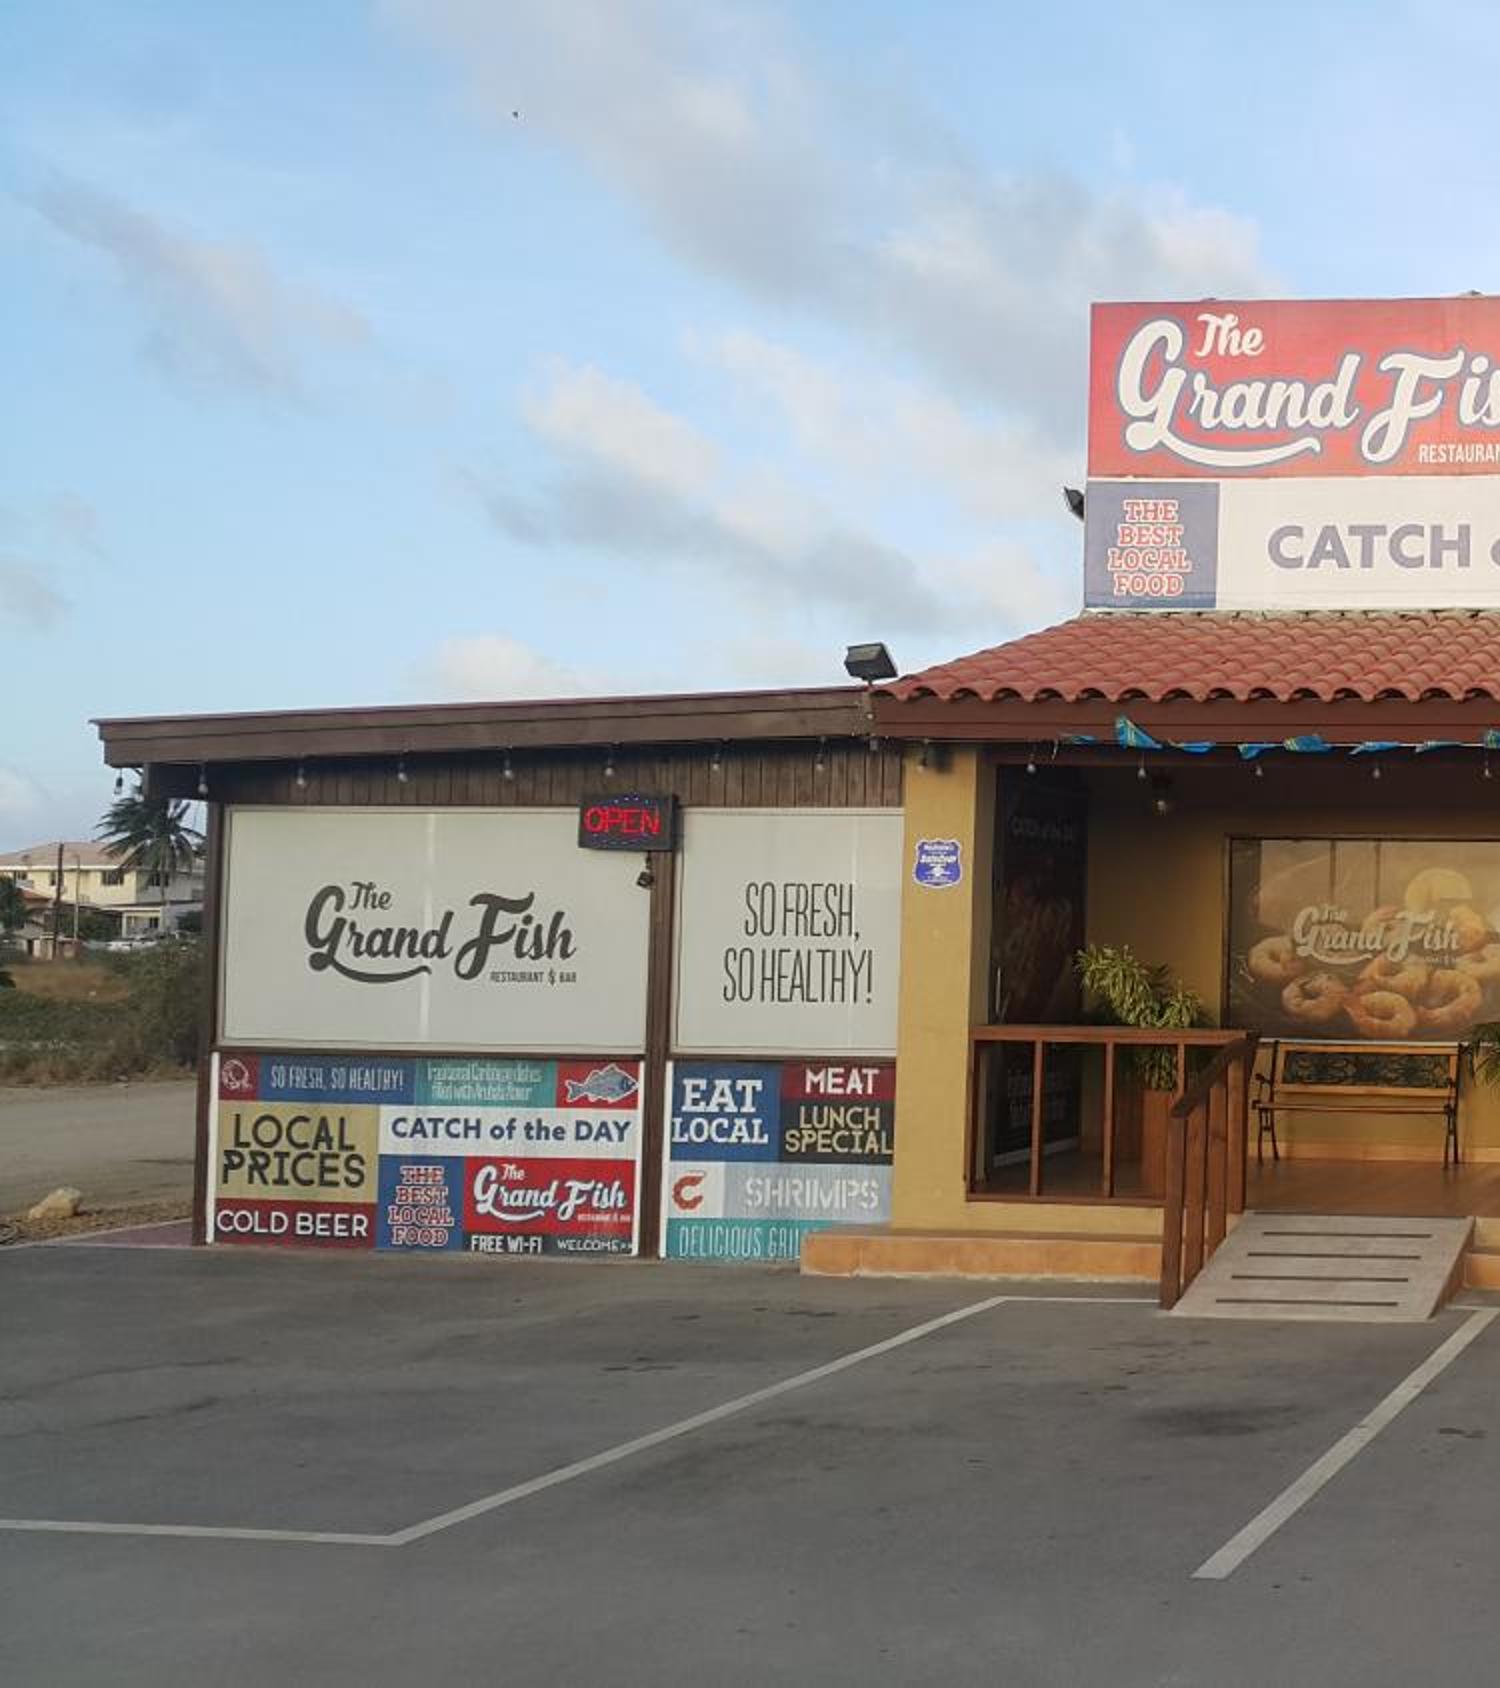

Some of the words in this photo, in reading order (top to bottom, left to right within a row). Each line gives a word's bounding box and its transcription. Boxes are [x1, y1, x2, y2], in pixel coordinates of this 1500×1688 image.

[1194, 313, 1265, 357] The
[1119, 320, 1360, 465] Grand
[1124, 500, 1177, 522] THE
[1118, 524, 1183, 546] BEST
[1267, 524, 1471, 569] CATCH
[1108, 549, 1191, 571] LOCAL
[1114, 574, 1183, 596] FOOD
[584, 806, 660, 834] OPEN
[349, 882, 392, 910] The
[745, 882, 776, 937] SO
[782, 883, 860, 941] FRESH,
[305, 885, 454, 984] Grand
[454, 892, 577, 981] Fish
[723, 948, 754, 1002] SO
[761, 949, 873, 1004] HEALTHY!
[271, 1066, 286, 1088] SO
[331, 1067, 345, 1088] SO
[805, 1067, 880, 1095] MEAT
[681, 1078, 763, 1113] EAT
[234, 1114, 355, 1150] LOCAL
[391, 1117, 481, 1139] CATCH
[490, 1117, 517, 1140] of
[523, 1119, 566, 1141] the
[574, 1120, 631, 1142] DAY
[671, 1117, 768, 1144] LOCAL
[800, 1106, 880, 1131] LUNCH
[785, 1129, 893, 1154] SPECIAL
[222, 1150, 366, 1188] PRICES
[400, 1166, 444, 1184] THE
[500, 1163, 526, 1182] The
[396, 1185, 449, 1205] BEST
[474, 1165, 558, 1221] Grand
[557, 1180, 626, 1221] Fish
[745, 1178, 880, 1210] SHRIMPS
[216, 1210, 288, 1233] COLD
[296, 1213, 368, 1236] BEER
[388, 1206, 455, 1227] LOCAL
[392, 1227, 449, 1246] FOOD
[471, 1235, 504, 1253] FREE
[507, 1235, 542, 1254] WI-FI
[679, 1225, 762, 1257] DELICIOUS
